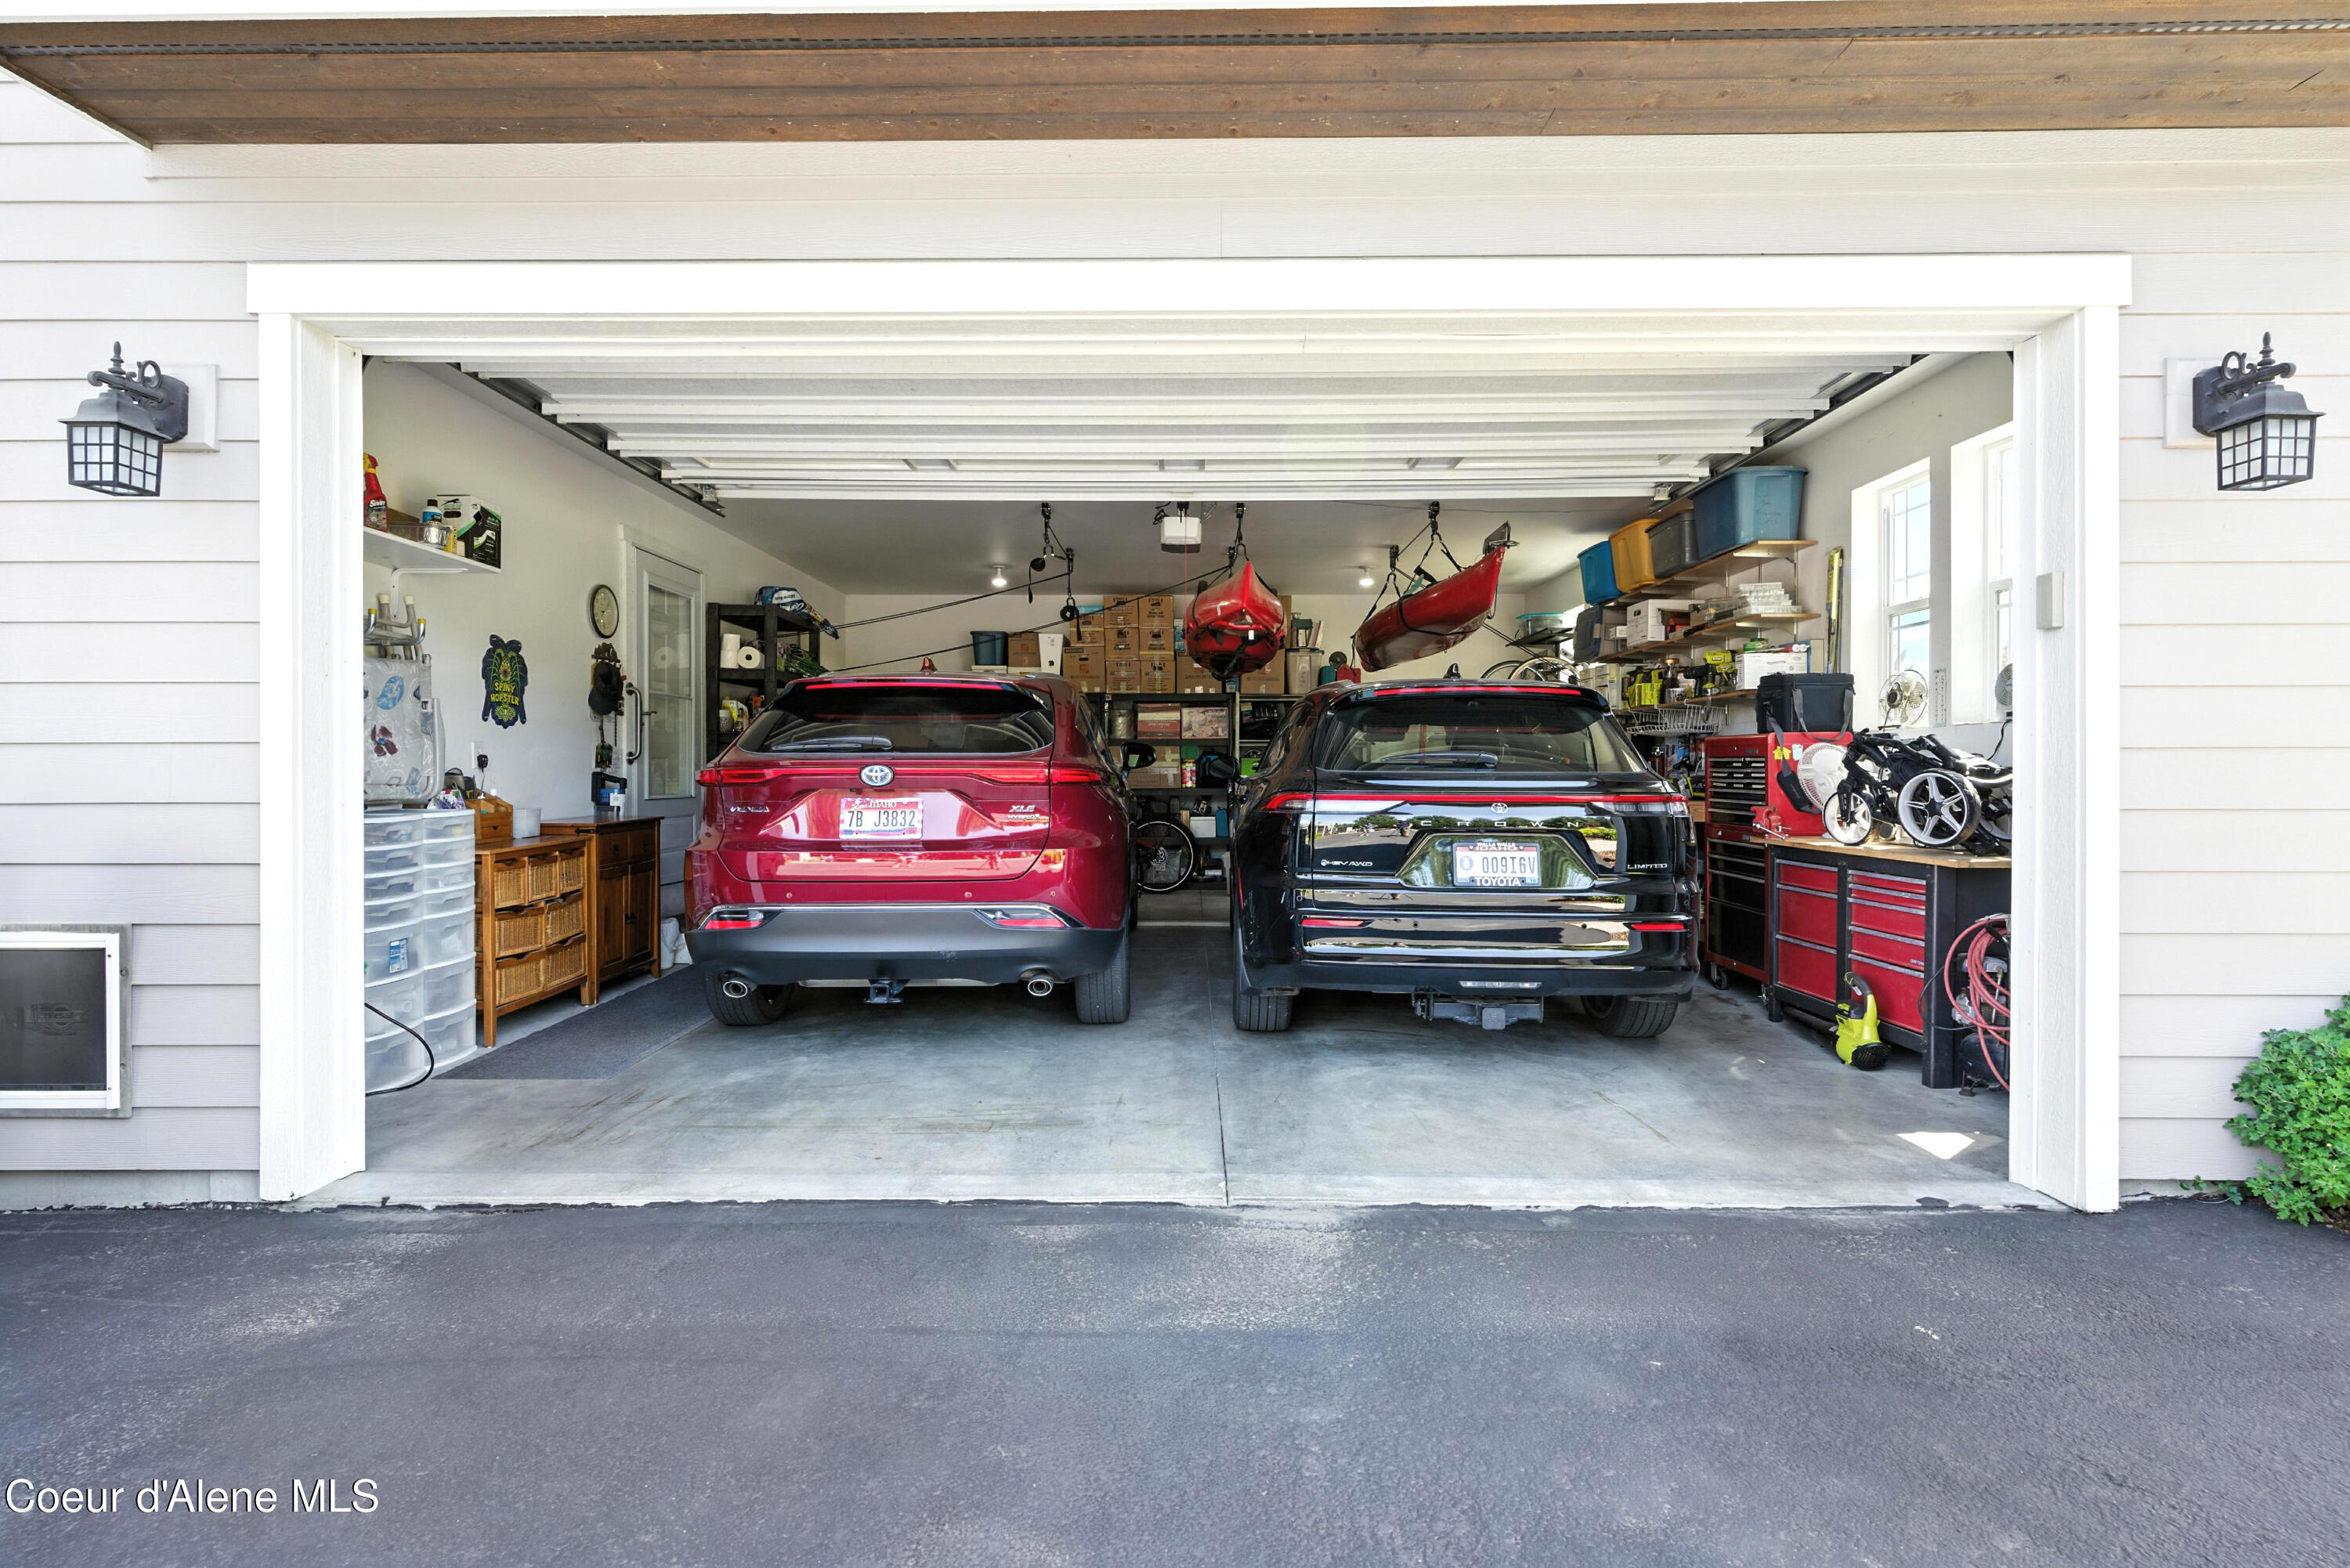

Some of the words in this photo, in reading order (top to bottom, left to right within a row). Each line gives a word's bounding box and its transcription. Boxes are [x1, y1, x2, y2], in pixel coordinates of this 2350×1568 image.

[494, 682, 515, 693] SPINY
[490, 693, 519, 706] HOPSTER
[1008, 804, 1036, 813] XLE
[848, 810, 863, 828] 7B
[874, 810, 916, 828] J3832
[1473, 876, 1522, 887] TOYOTA
